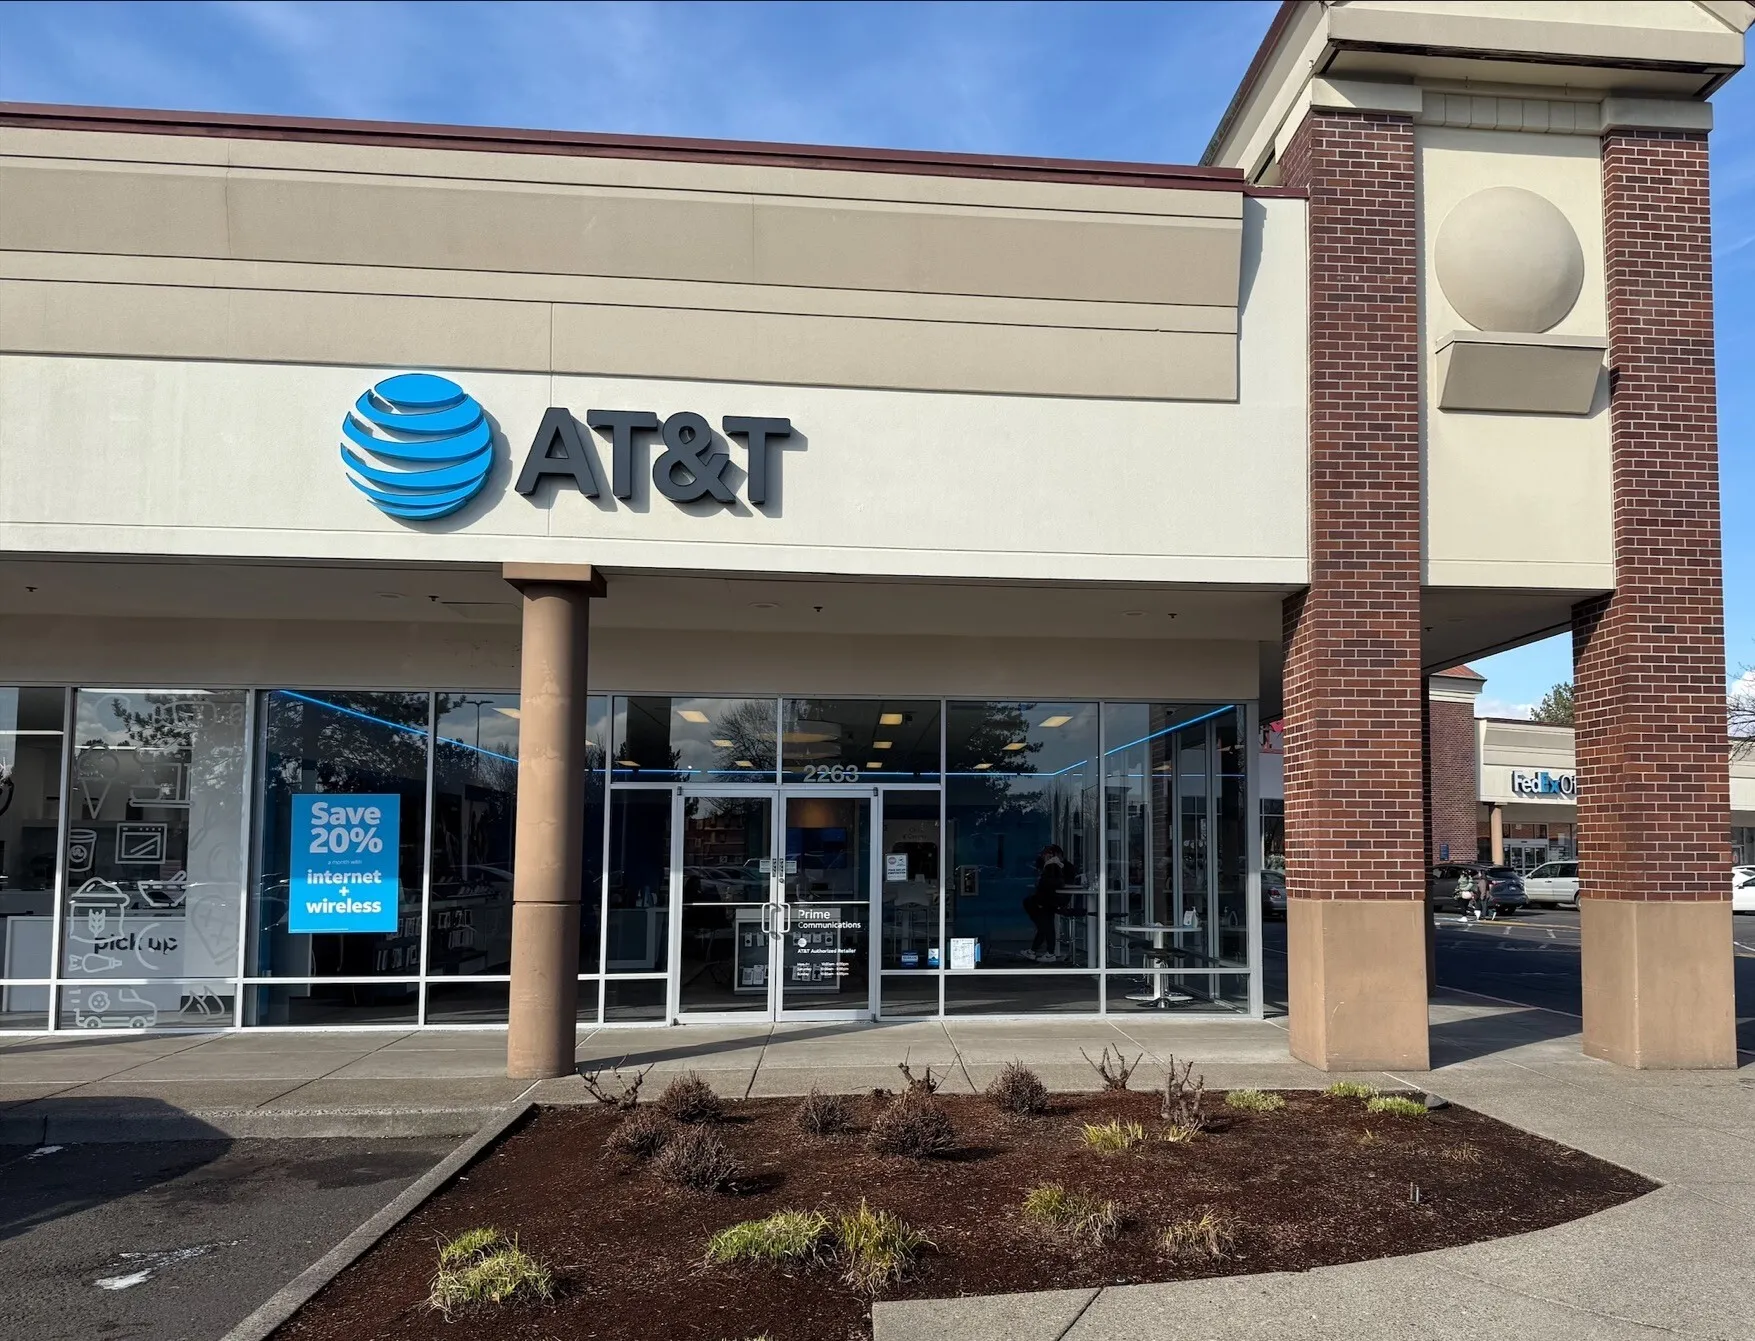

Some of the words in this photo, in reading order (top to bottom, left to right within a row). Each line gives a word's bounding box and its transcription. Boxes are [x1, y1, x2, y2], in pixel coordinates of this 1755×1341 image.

[514, 407, 791, 506] AT&T
[803, 764, 859, 782] 2263
[1512, 770, 1560, 793] FedEx
[311, 801, 381, 825] Save
[309, 827, 383, 853] 20%
[307, 869, 382, 884] internet
[339, 886, 350, 896] +
[306, 898, 381, 914] wireless
[797, 909, 831, 919] Prime
[94, 933, 143, 954] pick
[148, 937, 178, 955] up
